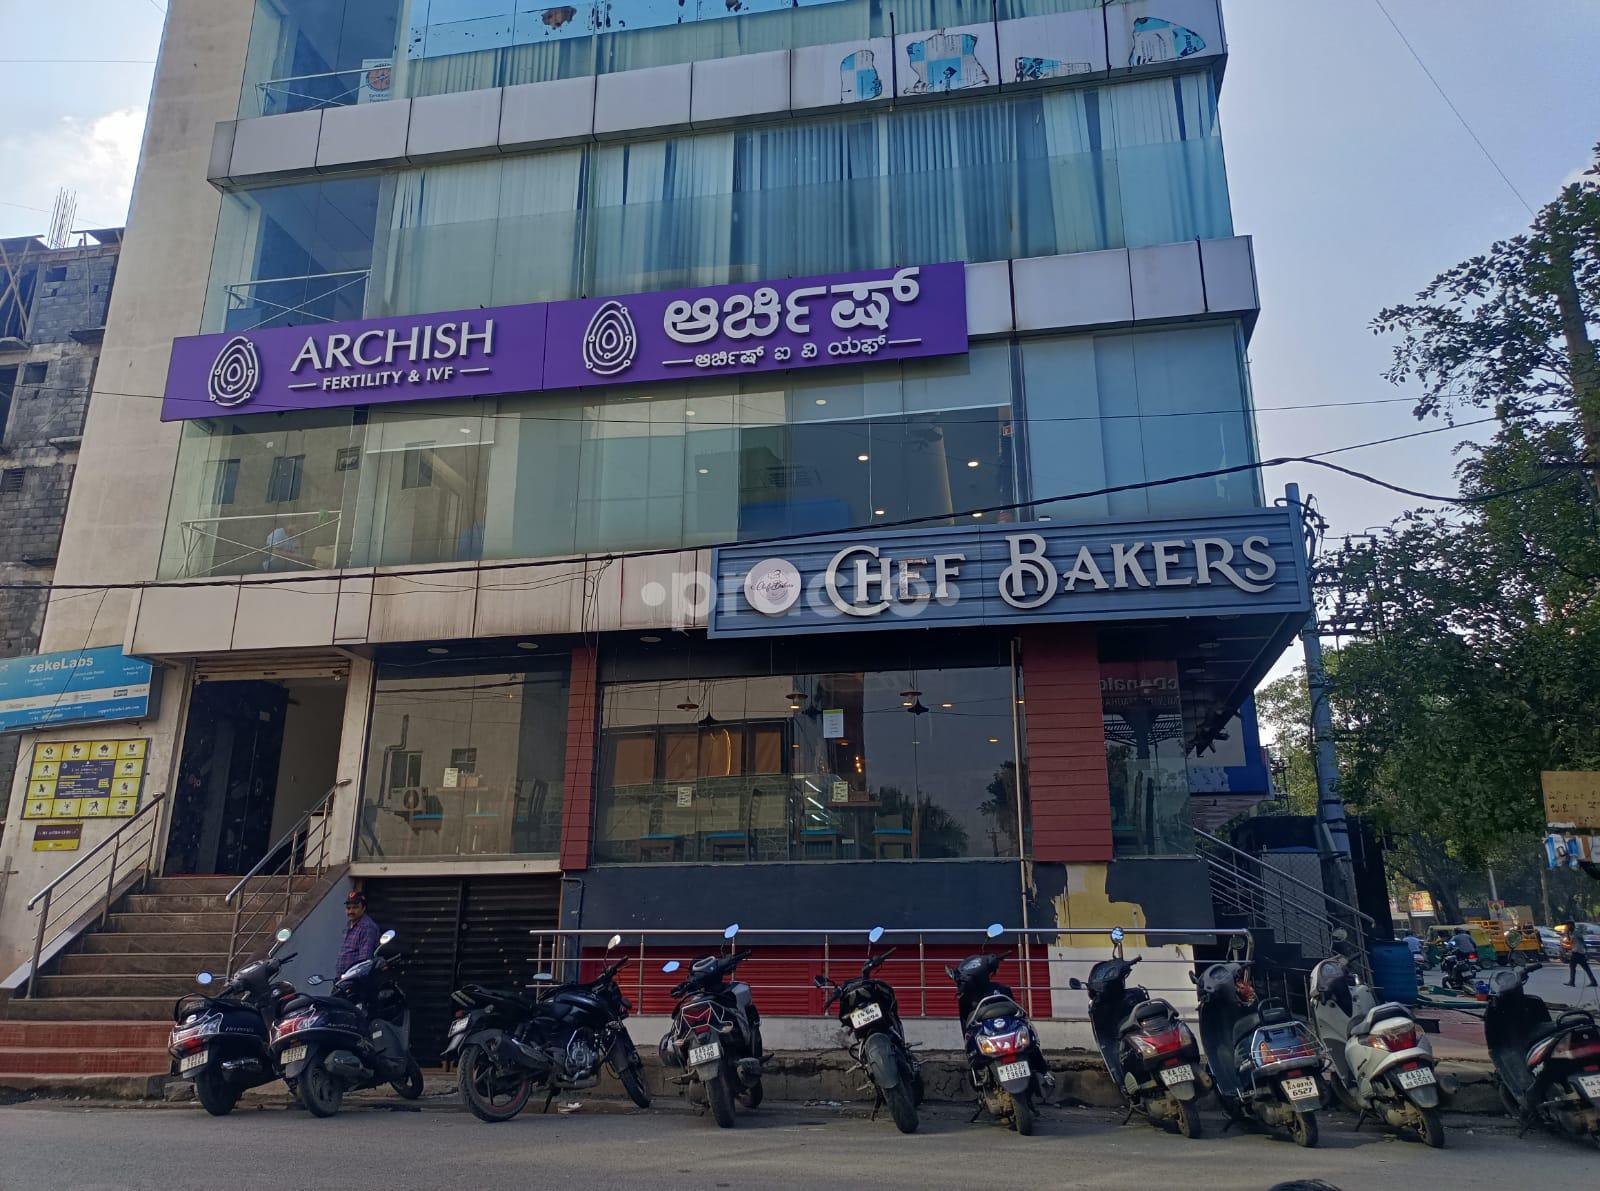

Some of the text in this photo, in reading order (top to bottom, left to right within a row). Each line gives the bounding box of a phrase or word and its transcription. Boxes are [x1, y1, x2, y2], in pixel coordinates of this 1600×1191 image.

[290, 320, 493, 372] ARCHISH
[322, 367, 453, 390] FERTILITY & IVF
[825, 533, 1277, 616] CHEF BAKERS
[29, 657, 94, 673] zekeLabs
